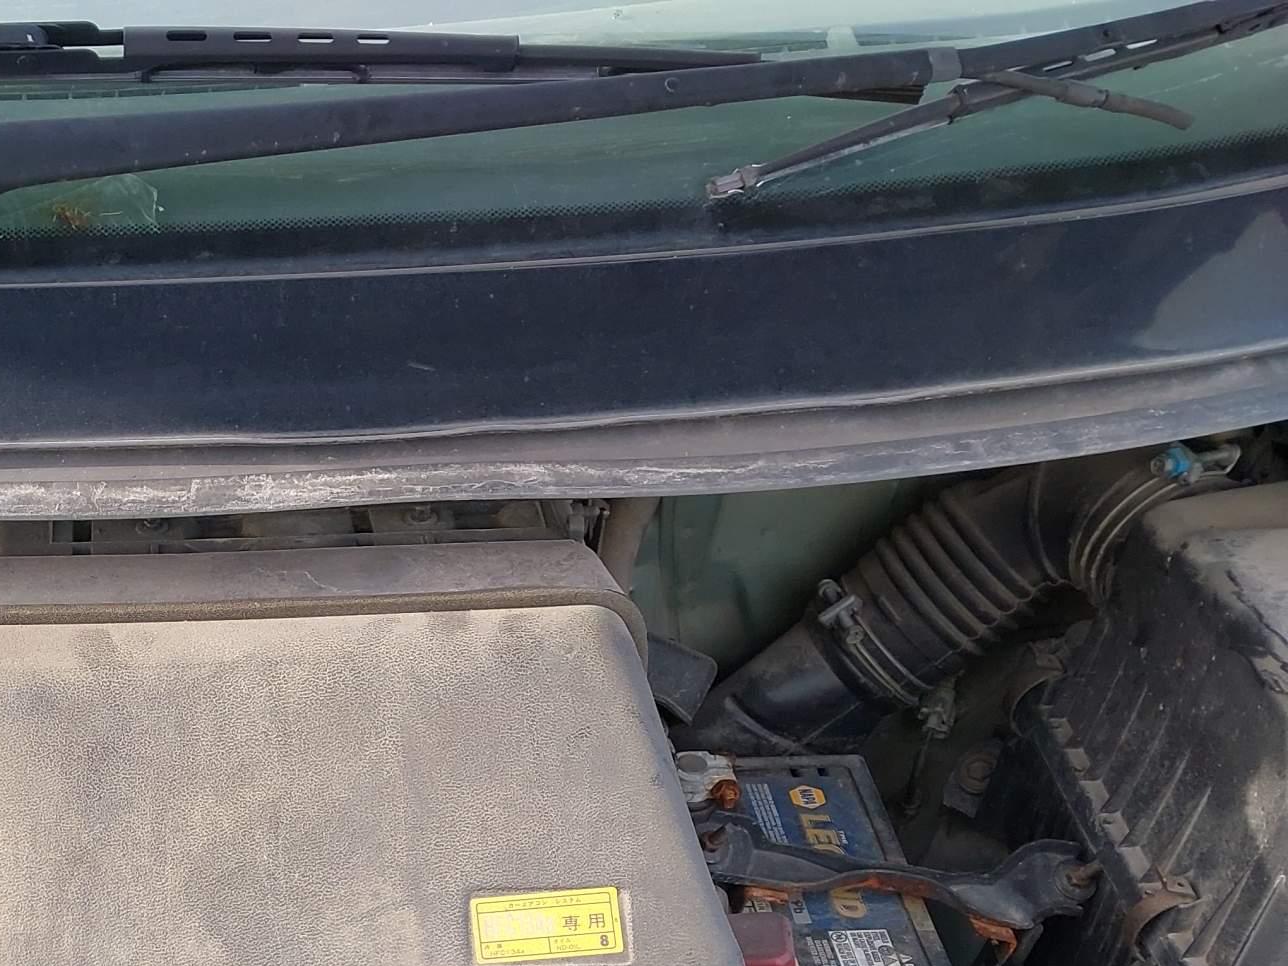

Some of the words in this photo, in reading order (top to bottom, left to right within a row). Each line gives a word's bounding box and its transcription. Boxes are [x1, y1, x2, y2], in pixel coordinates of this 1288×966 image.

[797, 788, 819, 805] NAPA
[837, 830, 849, 844] THE
[562, 912, 607, 932] 専用
[599, 934, 610, 947] 8
